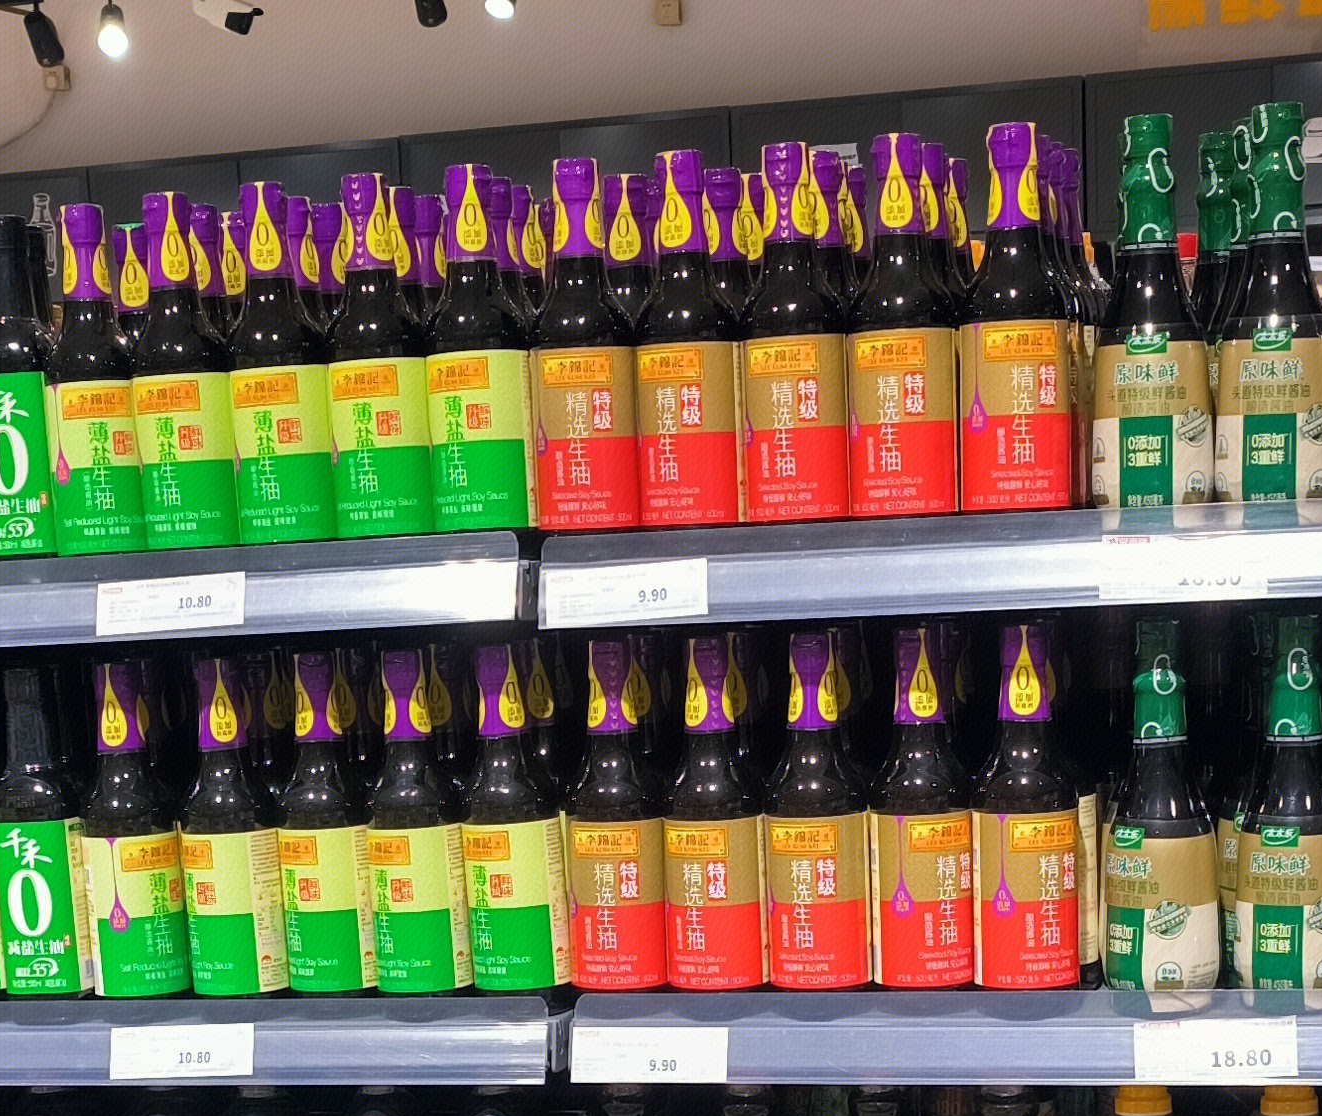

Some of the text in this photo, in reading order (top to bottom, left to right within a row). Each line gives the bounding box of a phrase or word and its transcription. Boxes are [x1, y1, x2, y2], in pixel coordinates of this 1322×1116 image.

[1039, 364, 1056, 406] 特级
[1114, 363, 1179, 385] 原味鲜
[1240, 358, 1303, 381] 原味鲜
[593, 390, 611, 431] 特级
[798, 380, 818, 421] 特级
[1011, 365, 1035, 464] 精选生抽
[566, 391, 591, 486] 精选生抽
[771, 380, 796, 477] 精选生抽
[177, 595, 212, 610] 10.80
[637, 588, 668, 603] 9.90
[619, 861, 639, 899] 特级
[816, 858, 836, 899] 特级
[1250, 853, 1312, 876] 原味鲜
[594, 861, 618, 952] 精选生抽
[791, 859, 814, 950] 精选生抽
[177, 1051, 212, 1065] 10.80
[648, 1059, 678, 1072] 9.90
[1210, 1049, 1273, 1069] 18.80
